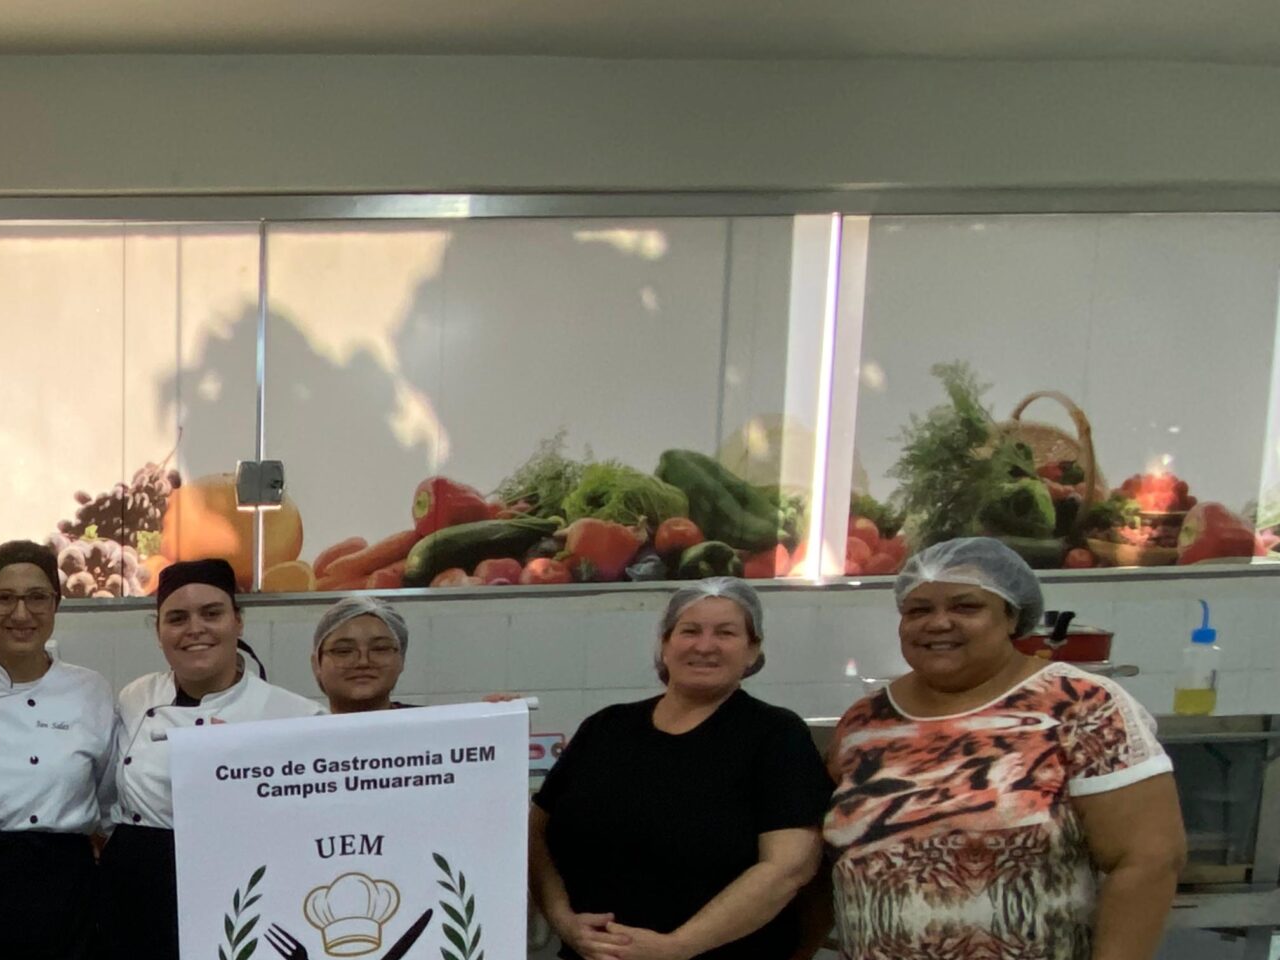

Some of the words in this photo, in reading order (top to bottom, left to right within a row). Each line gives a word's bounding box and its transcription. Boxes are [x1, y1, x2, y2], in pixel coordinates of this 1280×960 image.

[216, 764, 273, 780] Curso
[282, 761, 305, 774] de
[313, 751, 442, 773] Gastronomia
[450, 746, 495, 762] UEM
[257, 780, 337, 798] Campus
[345, 771, 454, 791] Umuarama
[314, 834, 384, 858] UEM
